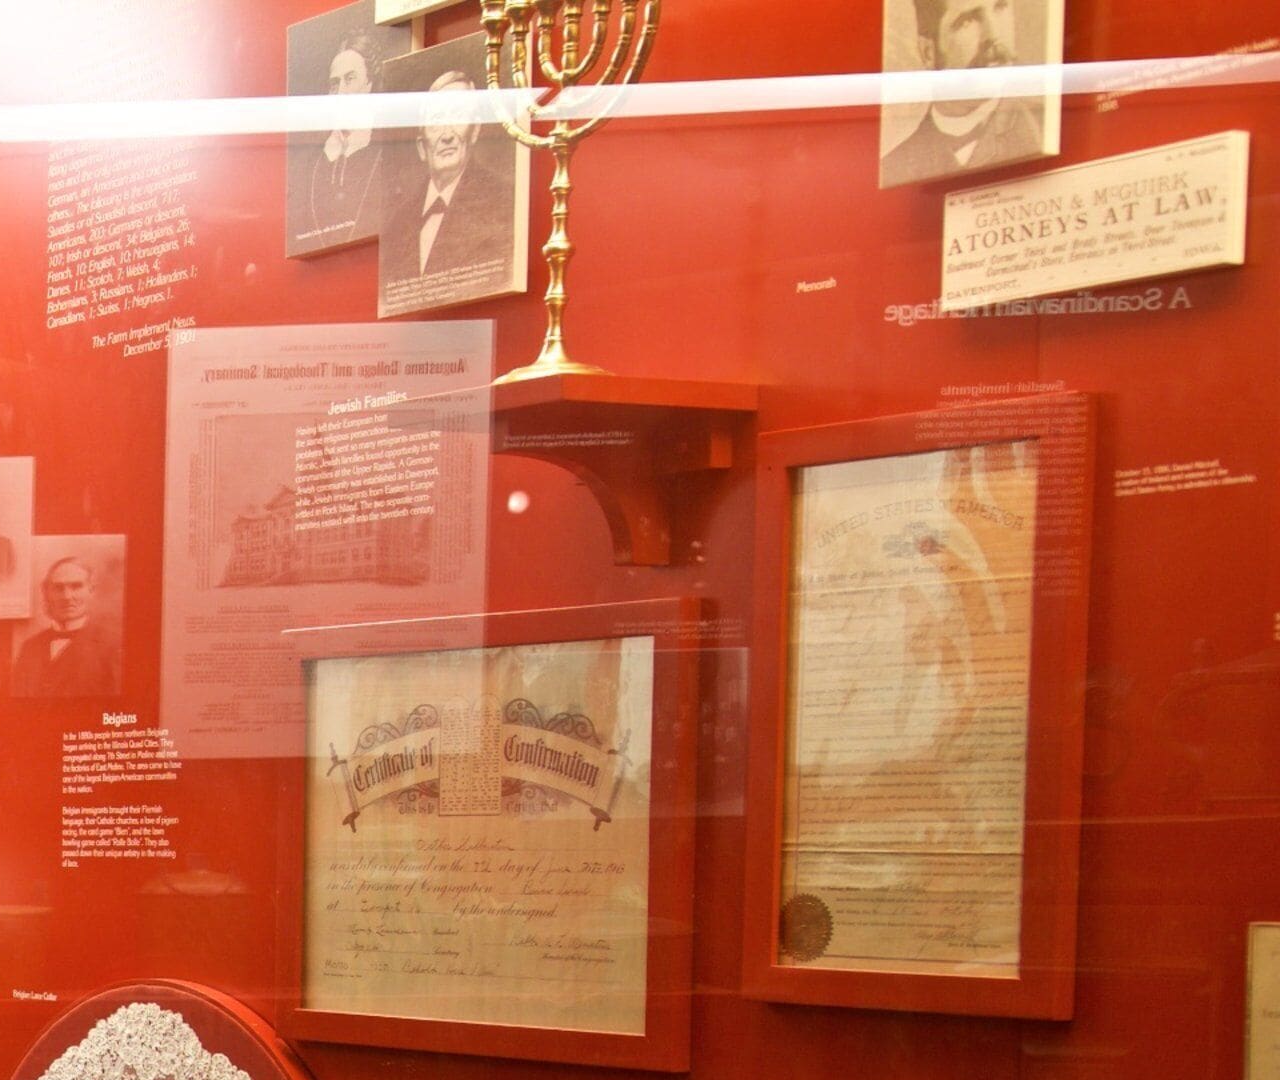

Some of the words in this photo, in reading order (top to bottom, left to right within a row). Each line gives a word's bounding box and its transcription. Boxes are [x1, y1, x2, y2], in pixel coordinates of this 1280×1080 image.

[975, 196, 1062, 228] GANNON
[1101, 202, 1141, 226] AT
[328, 398, 362, 415] Jewish
[364, 391, 407, 408] Families
[103, 712, 137, 727] Belgians
[352, 746, 417, 792] Certificate
[503, 734, 600, 790] Confirmation
